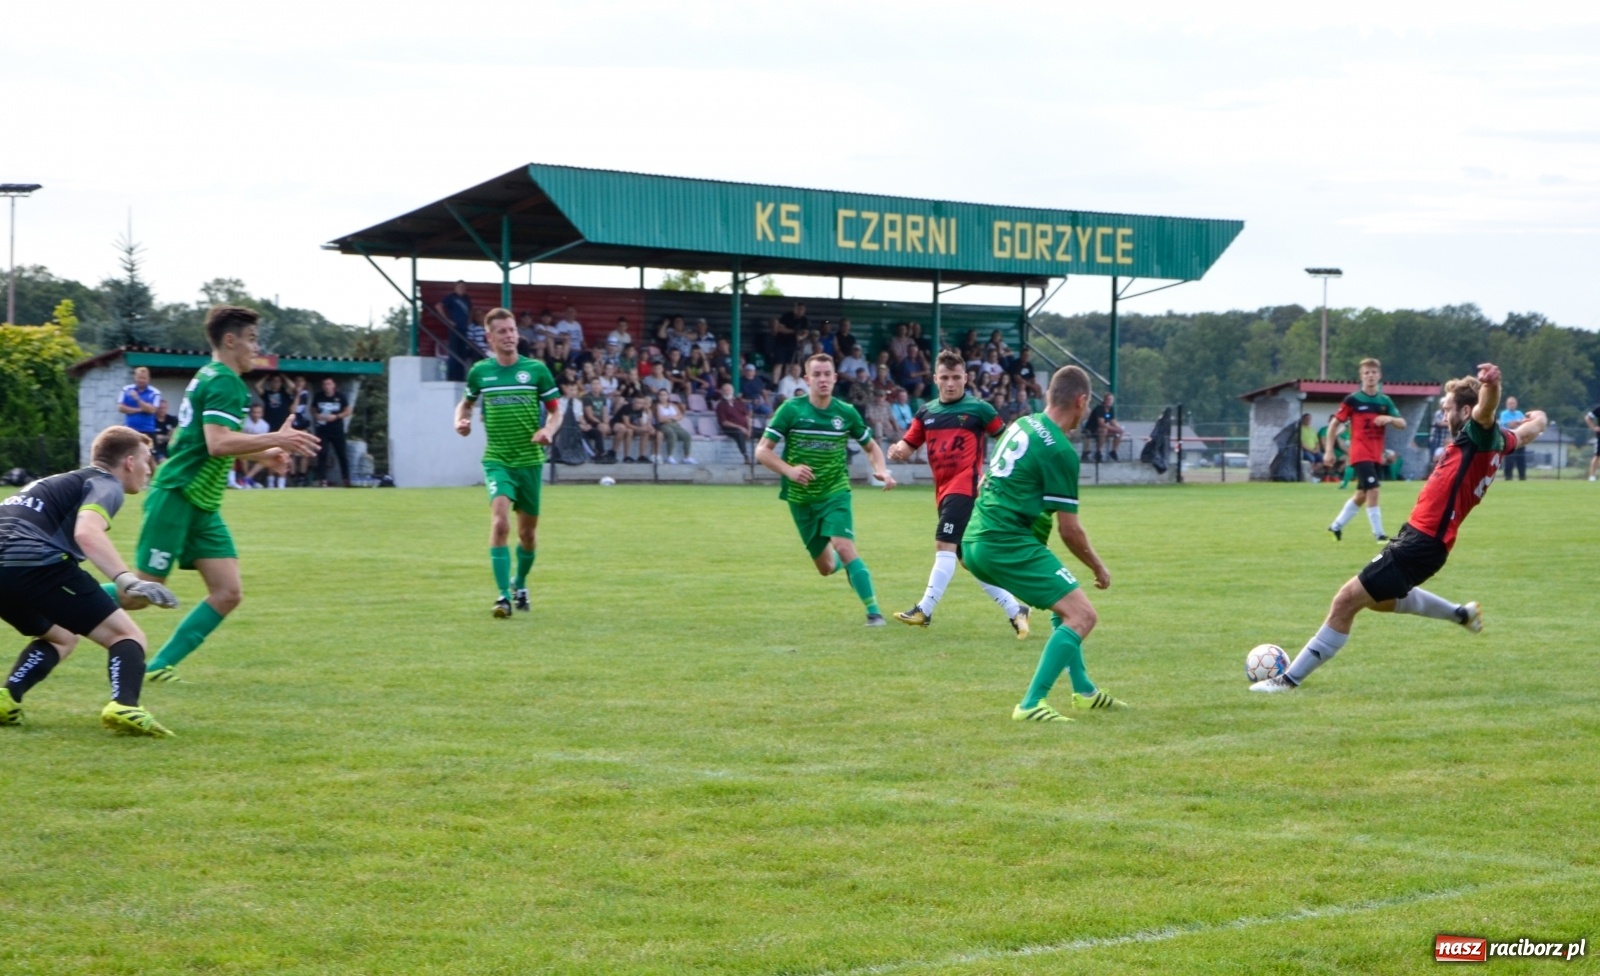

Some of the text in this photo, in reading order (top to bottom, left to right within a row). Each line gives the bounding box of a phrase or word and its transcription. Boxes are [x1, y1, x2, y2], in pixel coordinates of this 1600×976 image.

[755, 201, 1134, 265] KS CZARNI GORZYCE
[989, 422, 1029, 478] 13
[943, 522, 954, 534] 23
[148, 548, 172, 570] 16
